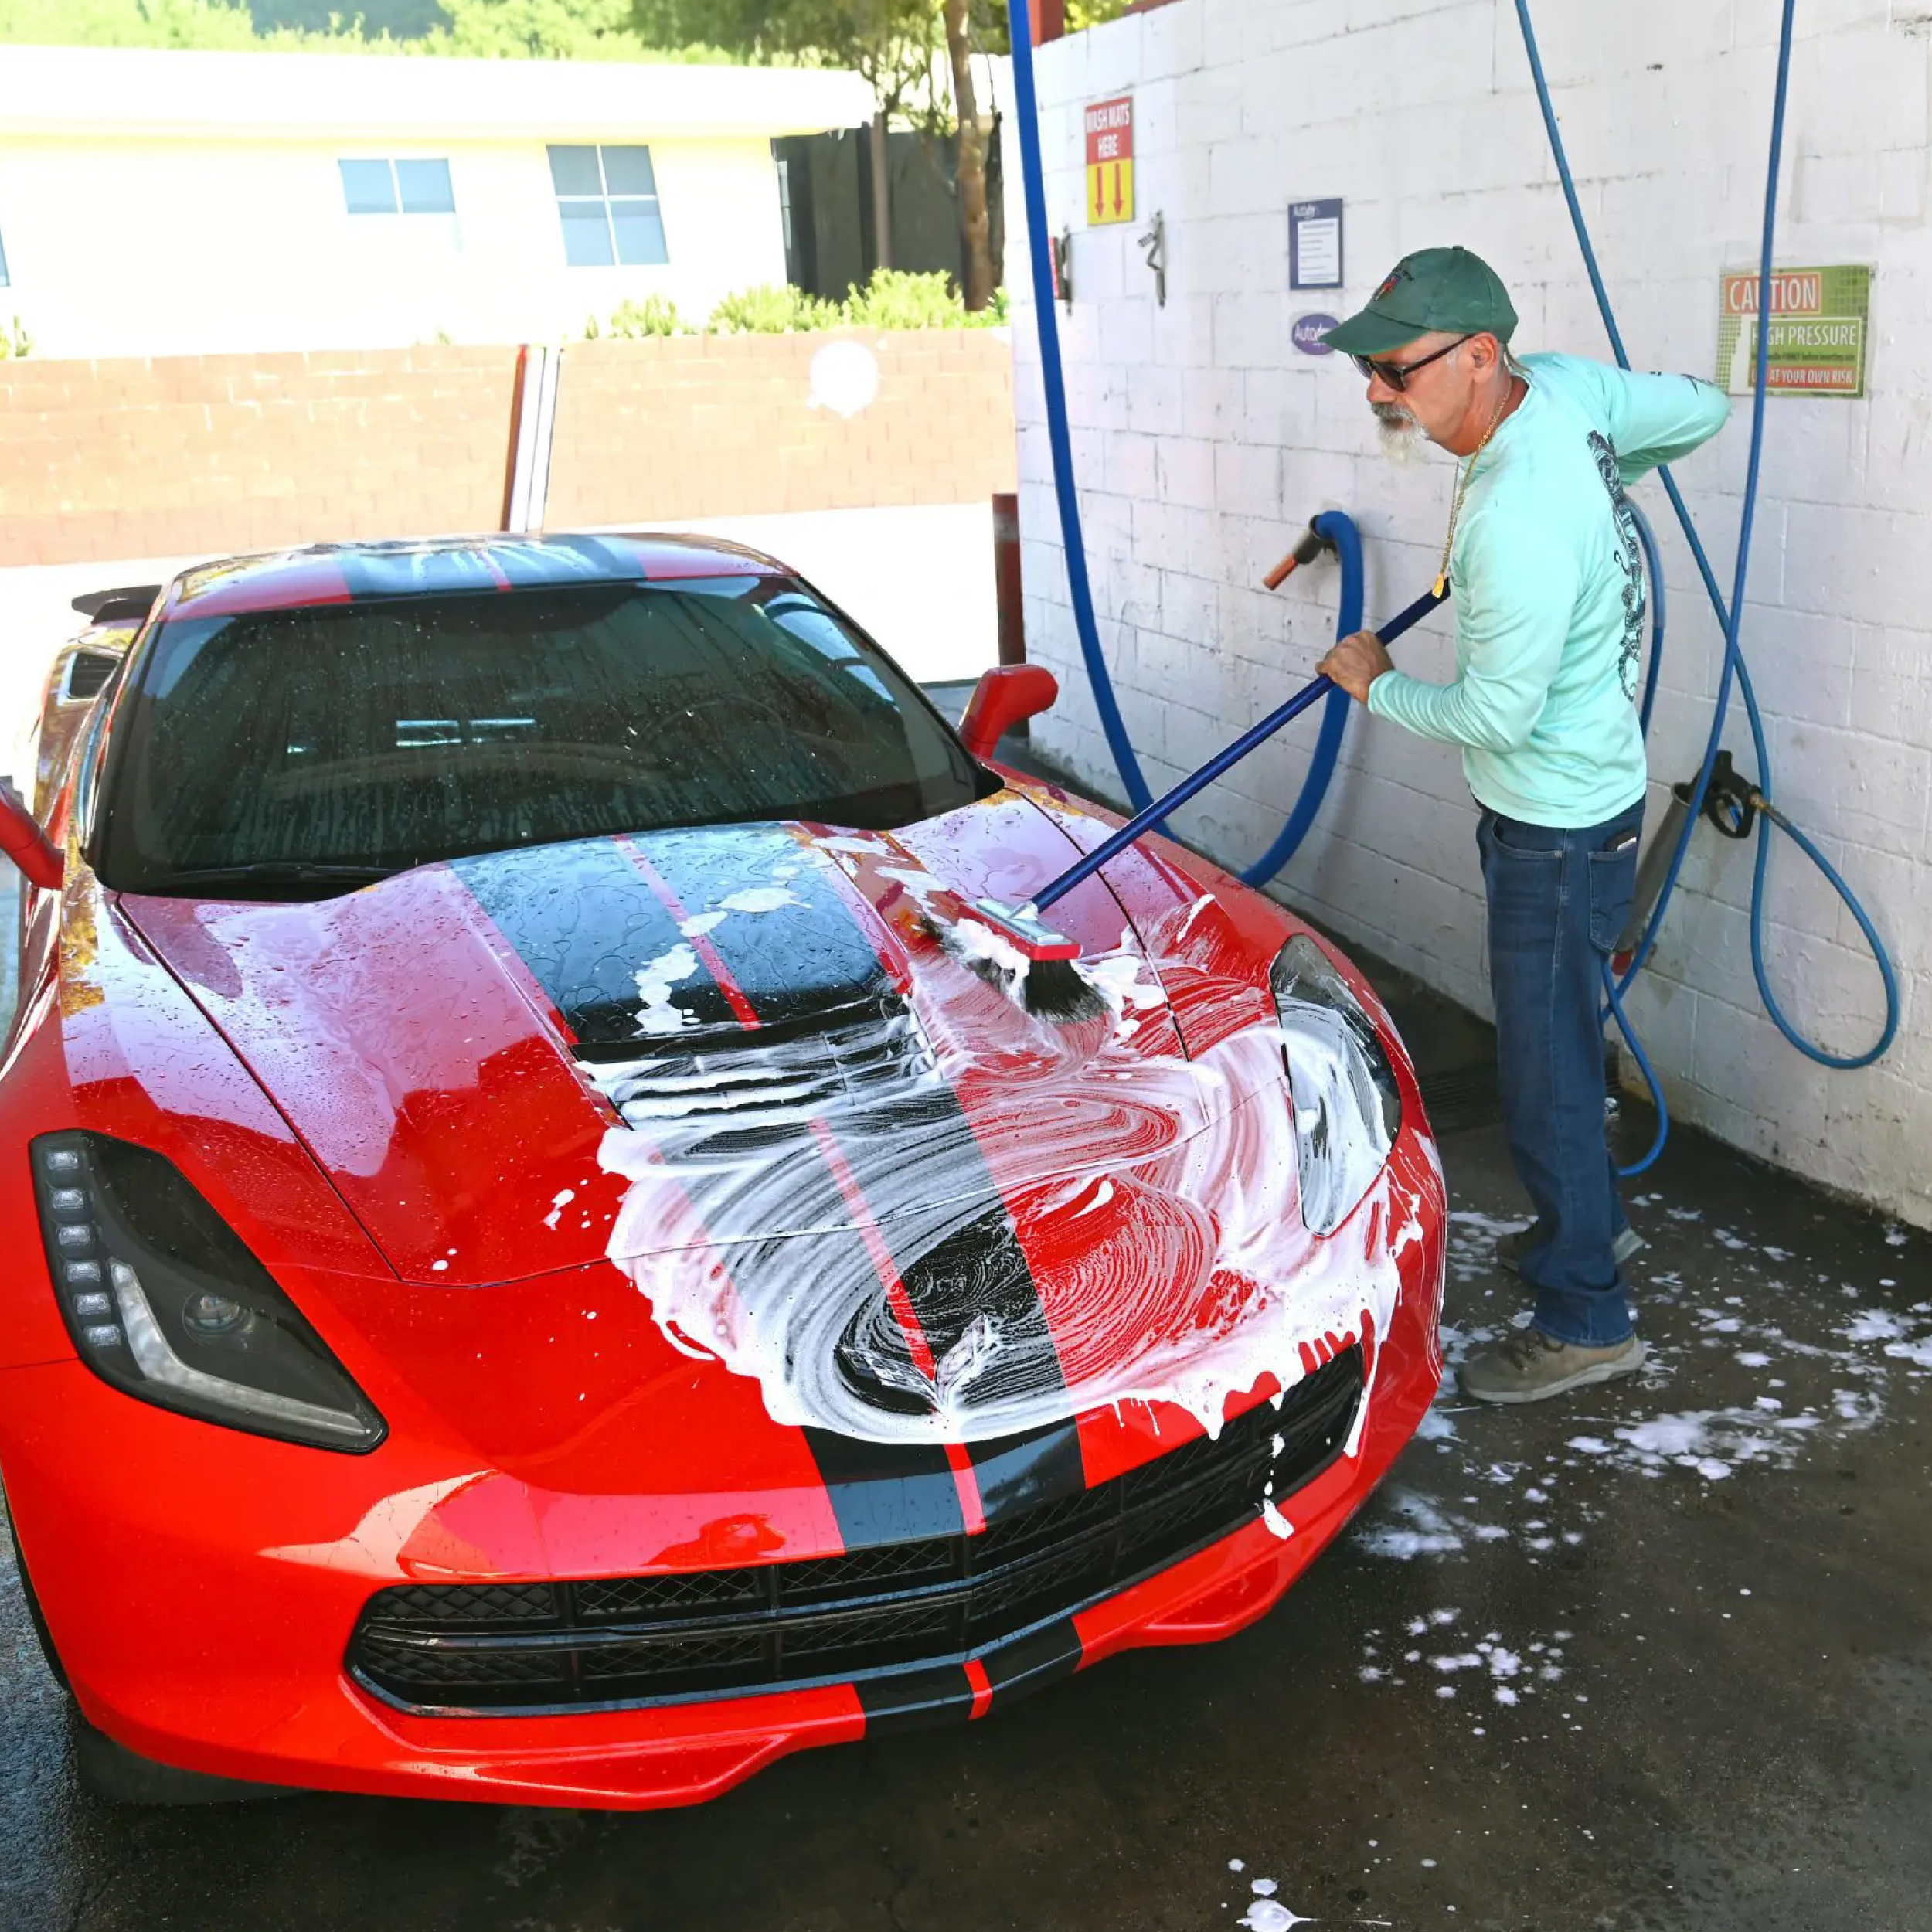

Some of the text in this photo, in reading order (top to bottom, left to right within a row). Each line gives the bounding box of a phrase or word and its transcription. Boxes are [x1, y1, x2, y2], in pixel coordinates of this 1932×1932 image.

[1087, 104, 1129, 133] WASH MATS
[1097, 134, 1117, 158] HERE
[1752, 325, 1857, 345] HGH PRESSURE
[1769, 369, 1780, 383] AT
[1781, 368, 1805, 383] YOUR
[1807, 368, 1830, 383] OWN
[1832, 369, 1852, 384] RISK
